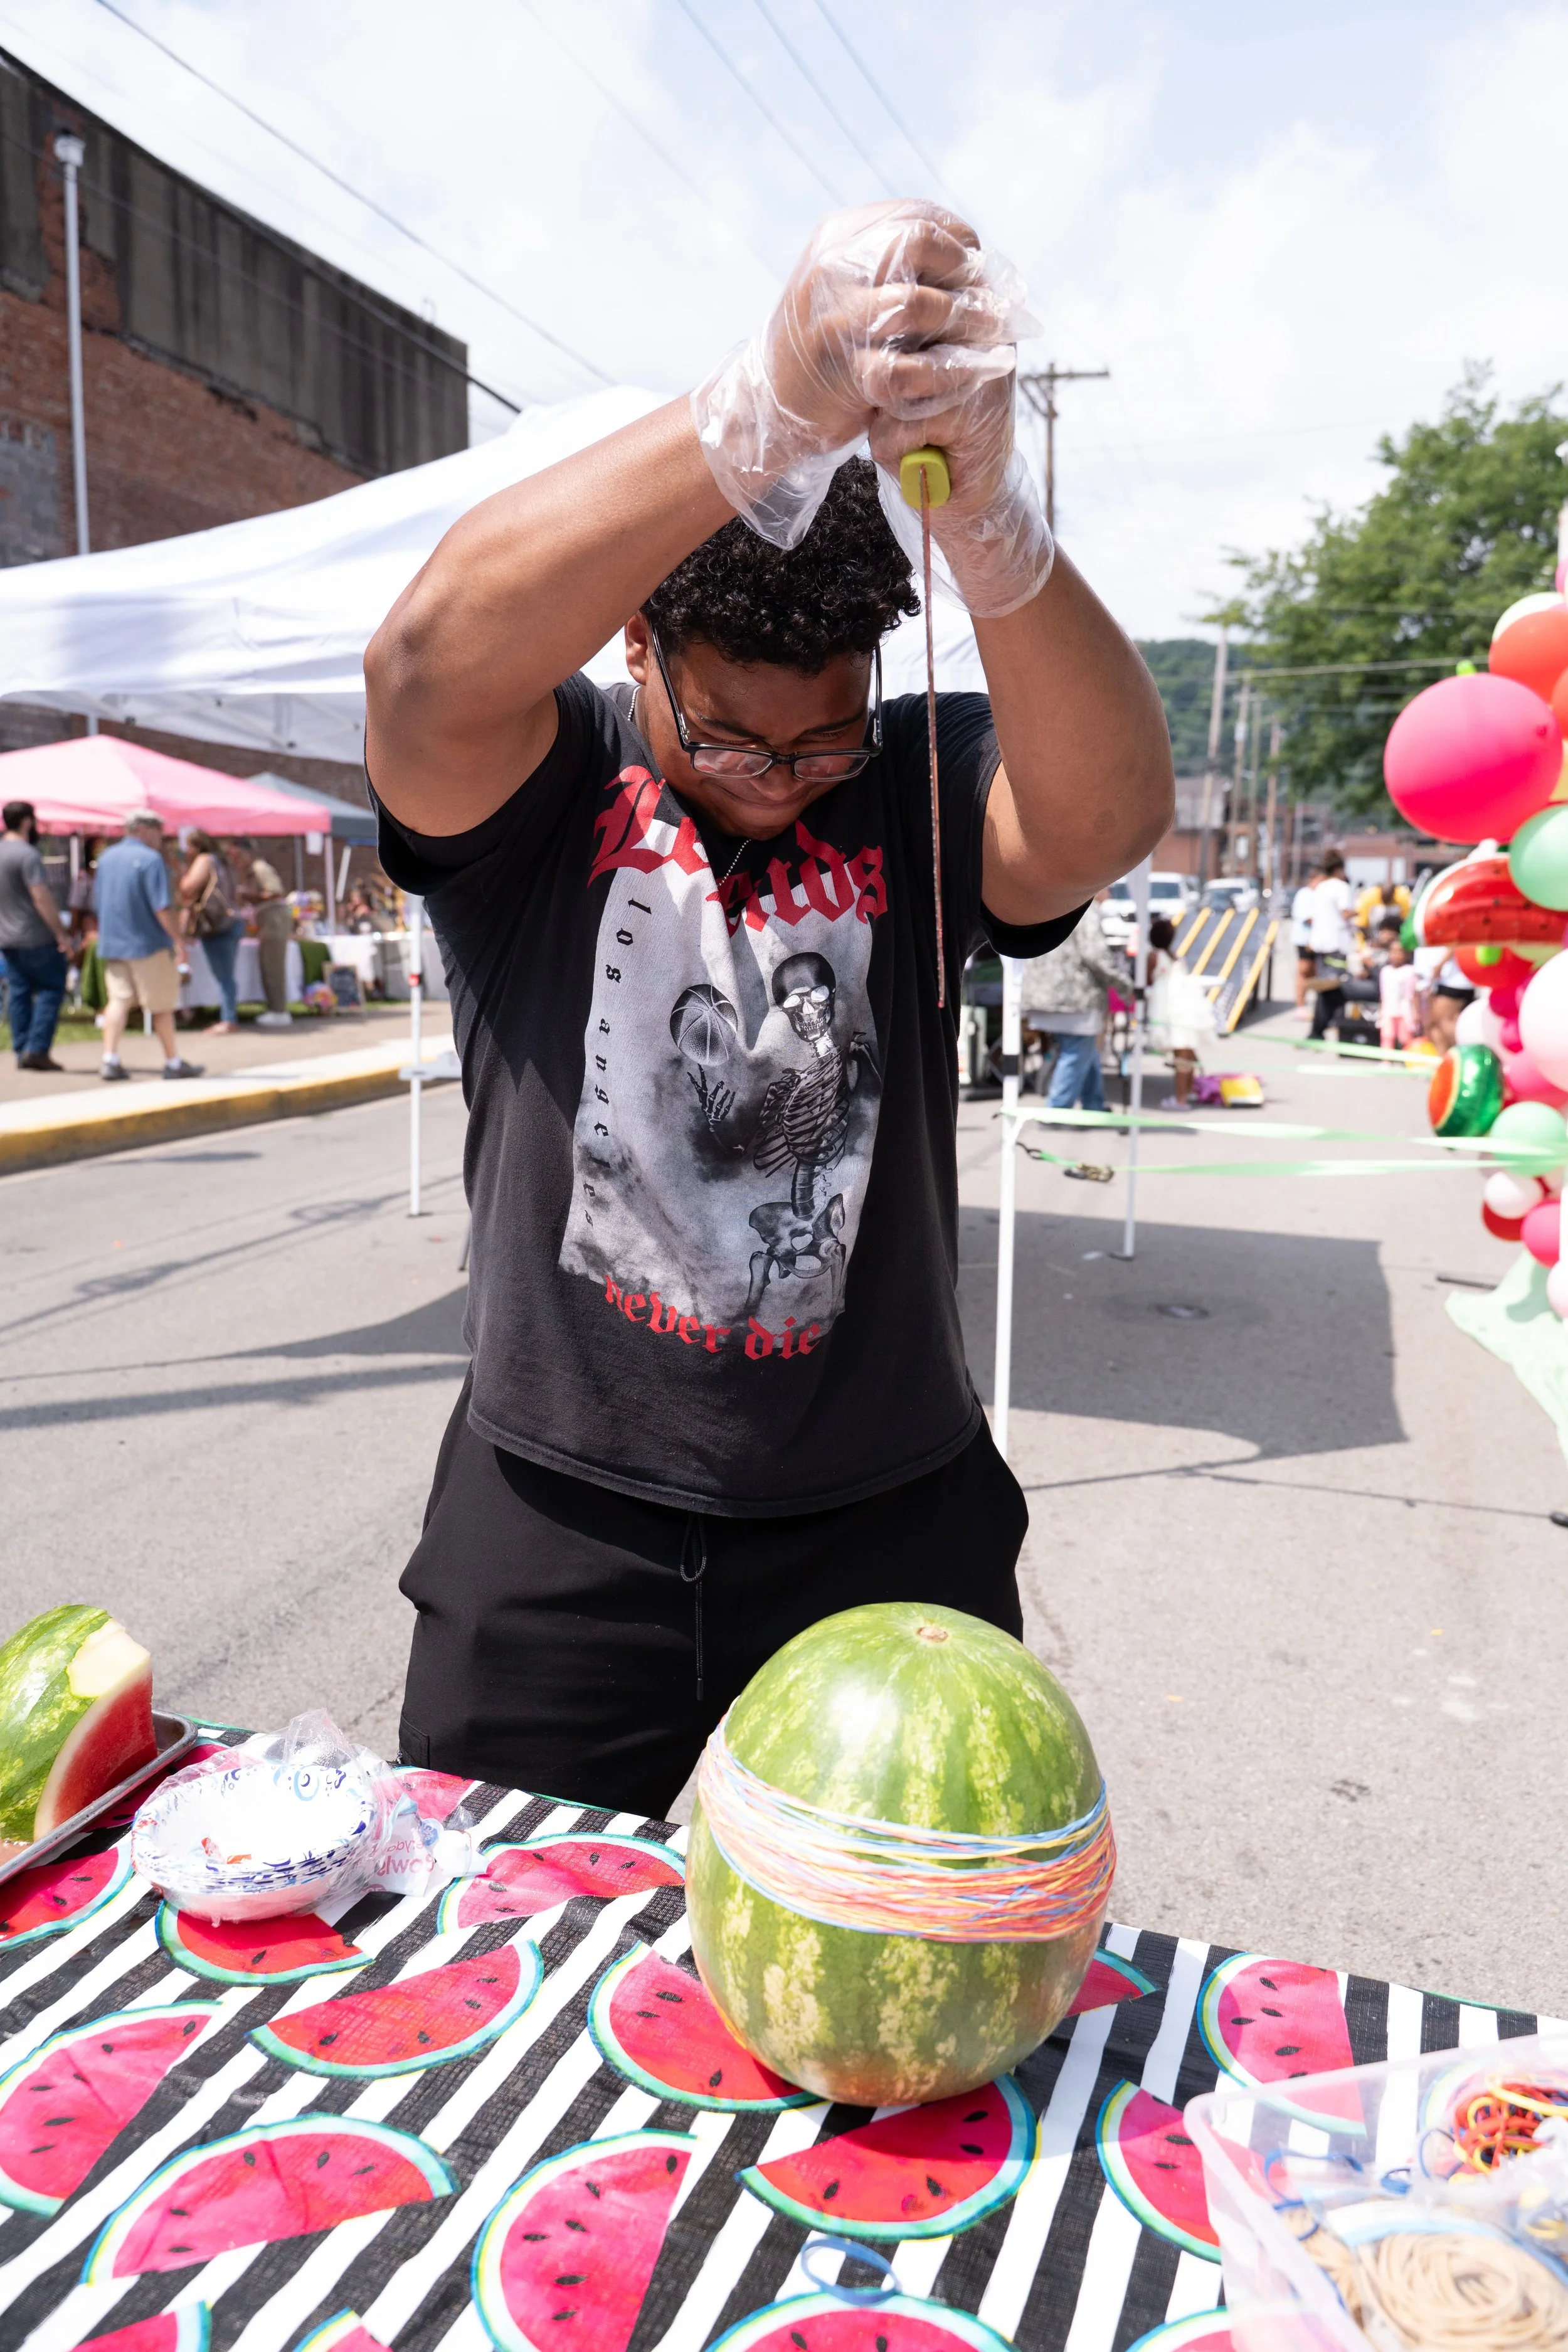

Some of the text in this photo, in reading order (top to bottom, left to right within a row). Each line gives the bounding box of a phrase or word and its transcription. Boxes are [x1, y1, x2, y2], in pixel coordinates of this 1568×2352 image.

[582, 898, 652, 1229] los angeles
[603, 1274, 821, 1360] never die
